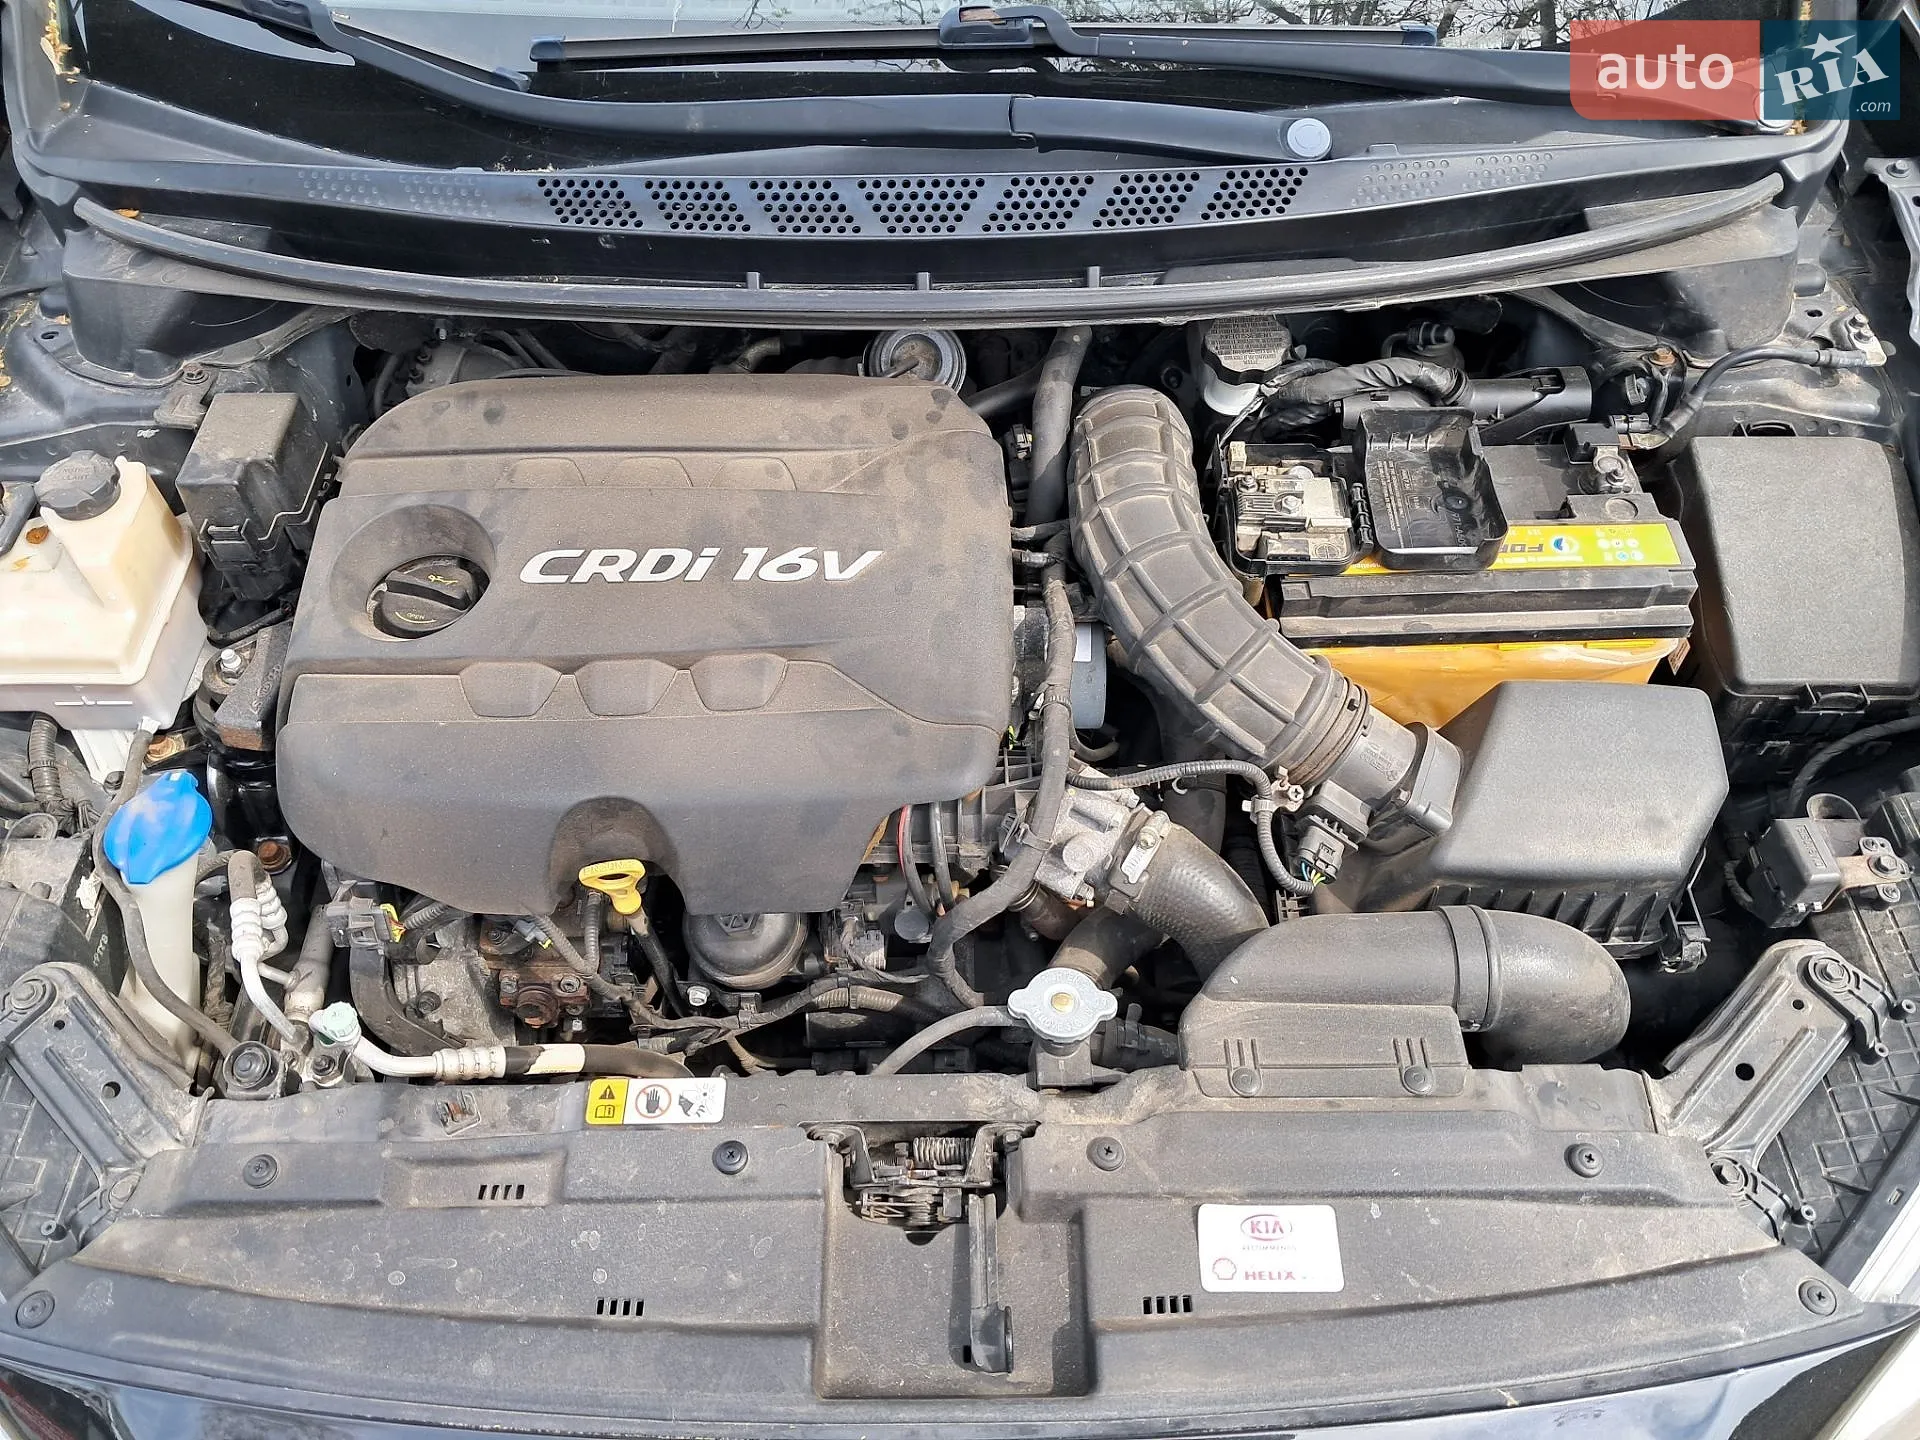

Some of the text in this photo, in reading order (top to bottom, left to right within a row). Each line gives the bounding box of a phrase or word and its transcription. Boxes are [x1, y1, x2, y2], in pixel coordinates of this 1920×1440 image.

[519, 546, 885, 584] CRDi 16V
[1250, 1220, 1285, 1234] KIA
[1244, 1271, 1296, 1281] HELIX
